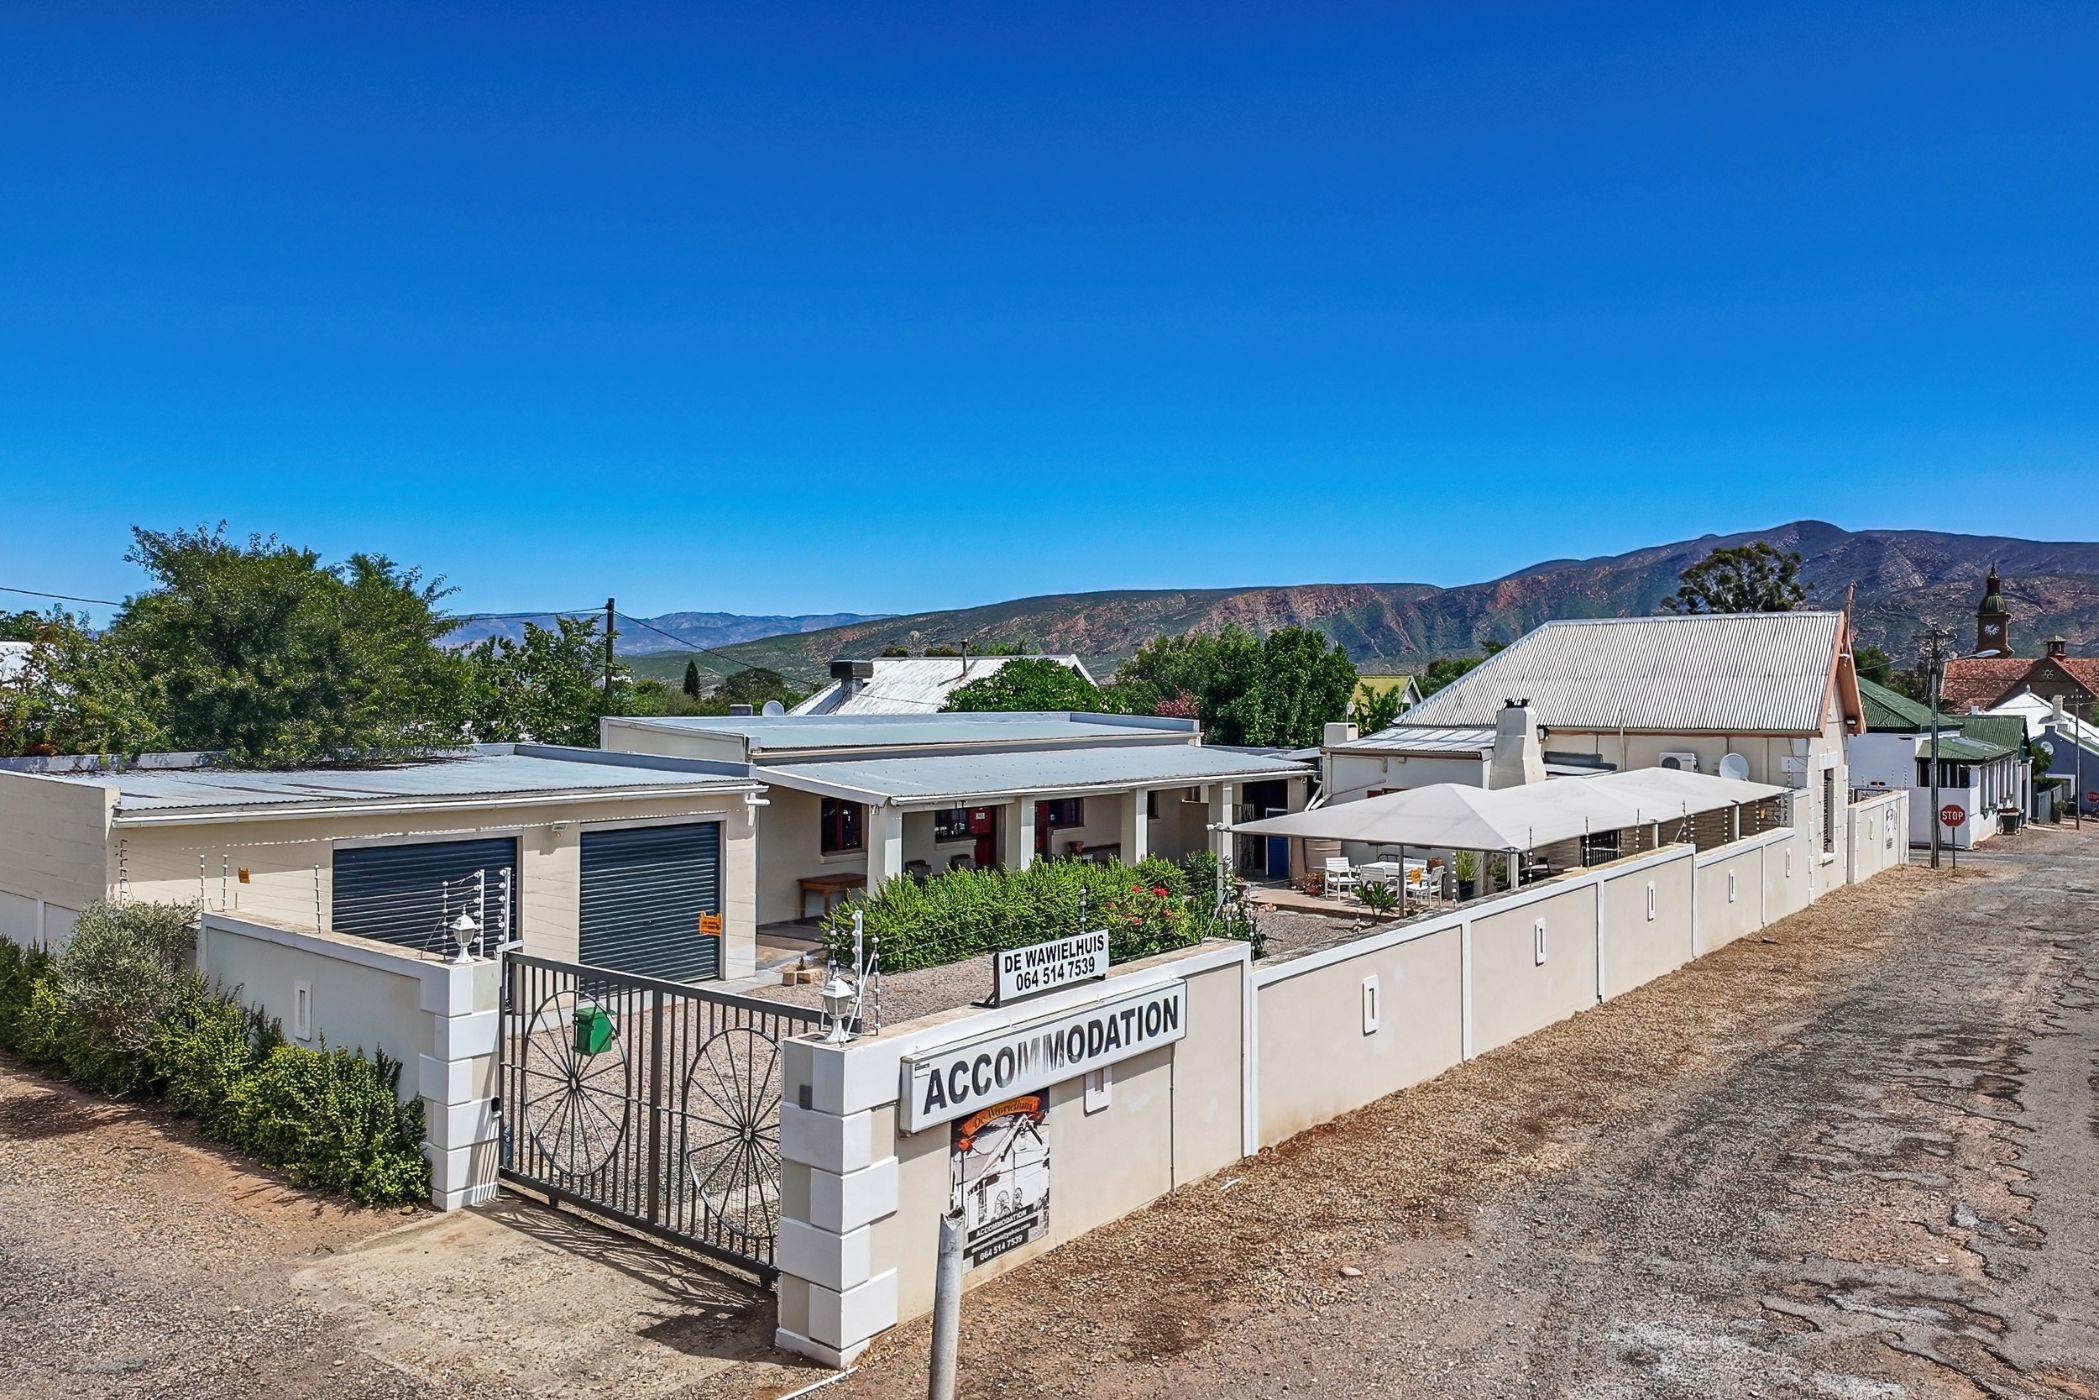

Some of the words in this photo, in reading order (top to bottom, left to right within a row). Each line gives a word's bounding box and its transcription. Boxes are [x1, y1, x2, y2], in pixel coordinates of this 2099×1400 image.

[1942, 810, 1964, 820] STOP
[1004, 953, 1021, 974] DE
[1025, 934, 1104, 968] WAWIELHUIS
[1016, 969, 1039, 991] 064
[1043, 963, 1065, 984] 514
[1068, 956, 1095, 979] 7539
[923, 995, 1179, 1115] ACCOMMODATION
[976, 1209, 1027, 1238] ACCOMMODATION
[980, 1249, 993, 1260] 064
[993, 1241, 1006, 1254] 514
[1007, 1234, 1023, 1248] 7539
